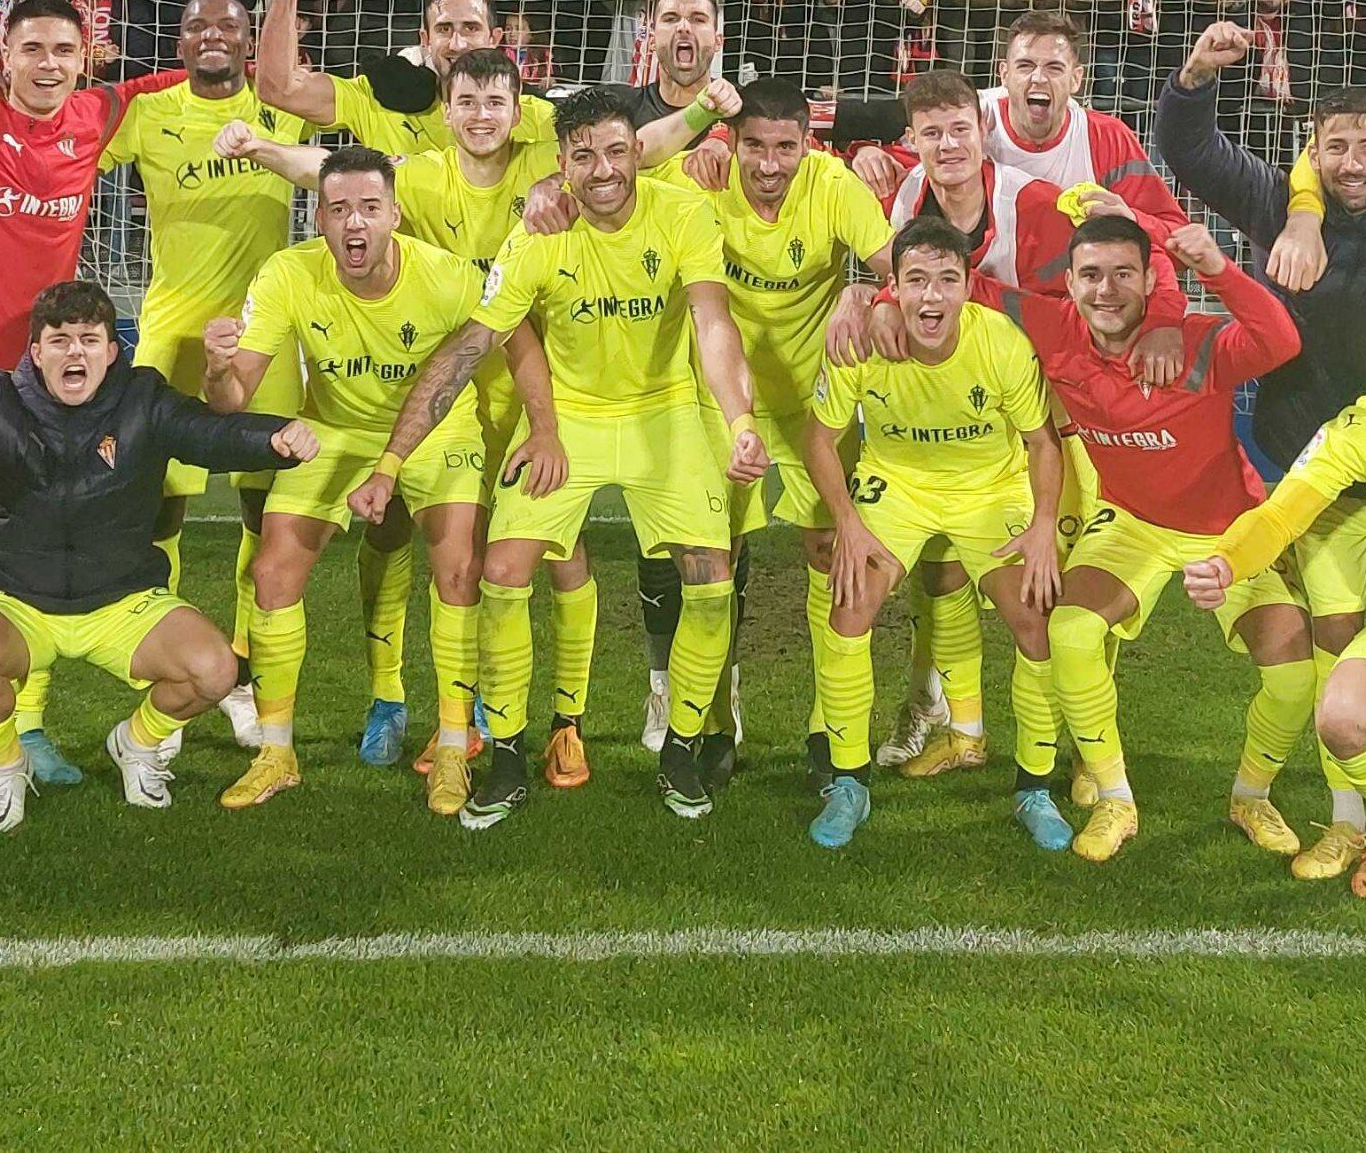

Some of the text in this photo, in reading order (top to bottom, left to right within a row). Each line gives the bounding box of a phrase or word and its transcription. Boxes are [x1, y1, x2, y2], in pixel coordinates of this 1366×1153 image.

[724, 260, 800, 291] INTEGRA
[597, 295, 665, 322] INTEGRA
[346, 354, 419, 381] INTEGRA
[911, 422, 994, 442] INTEGRA
[1091, 429, 1178, 451] INTEGRA
